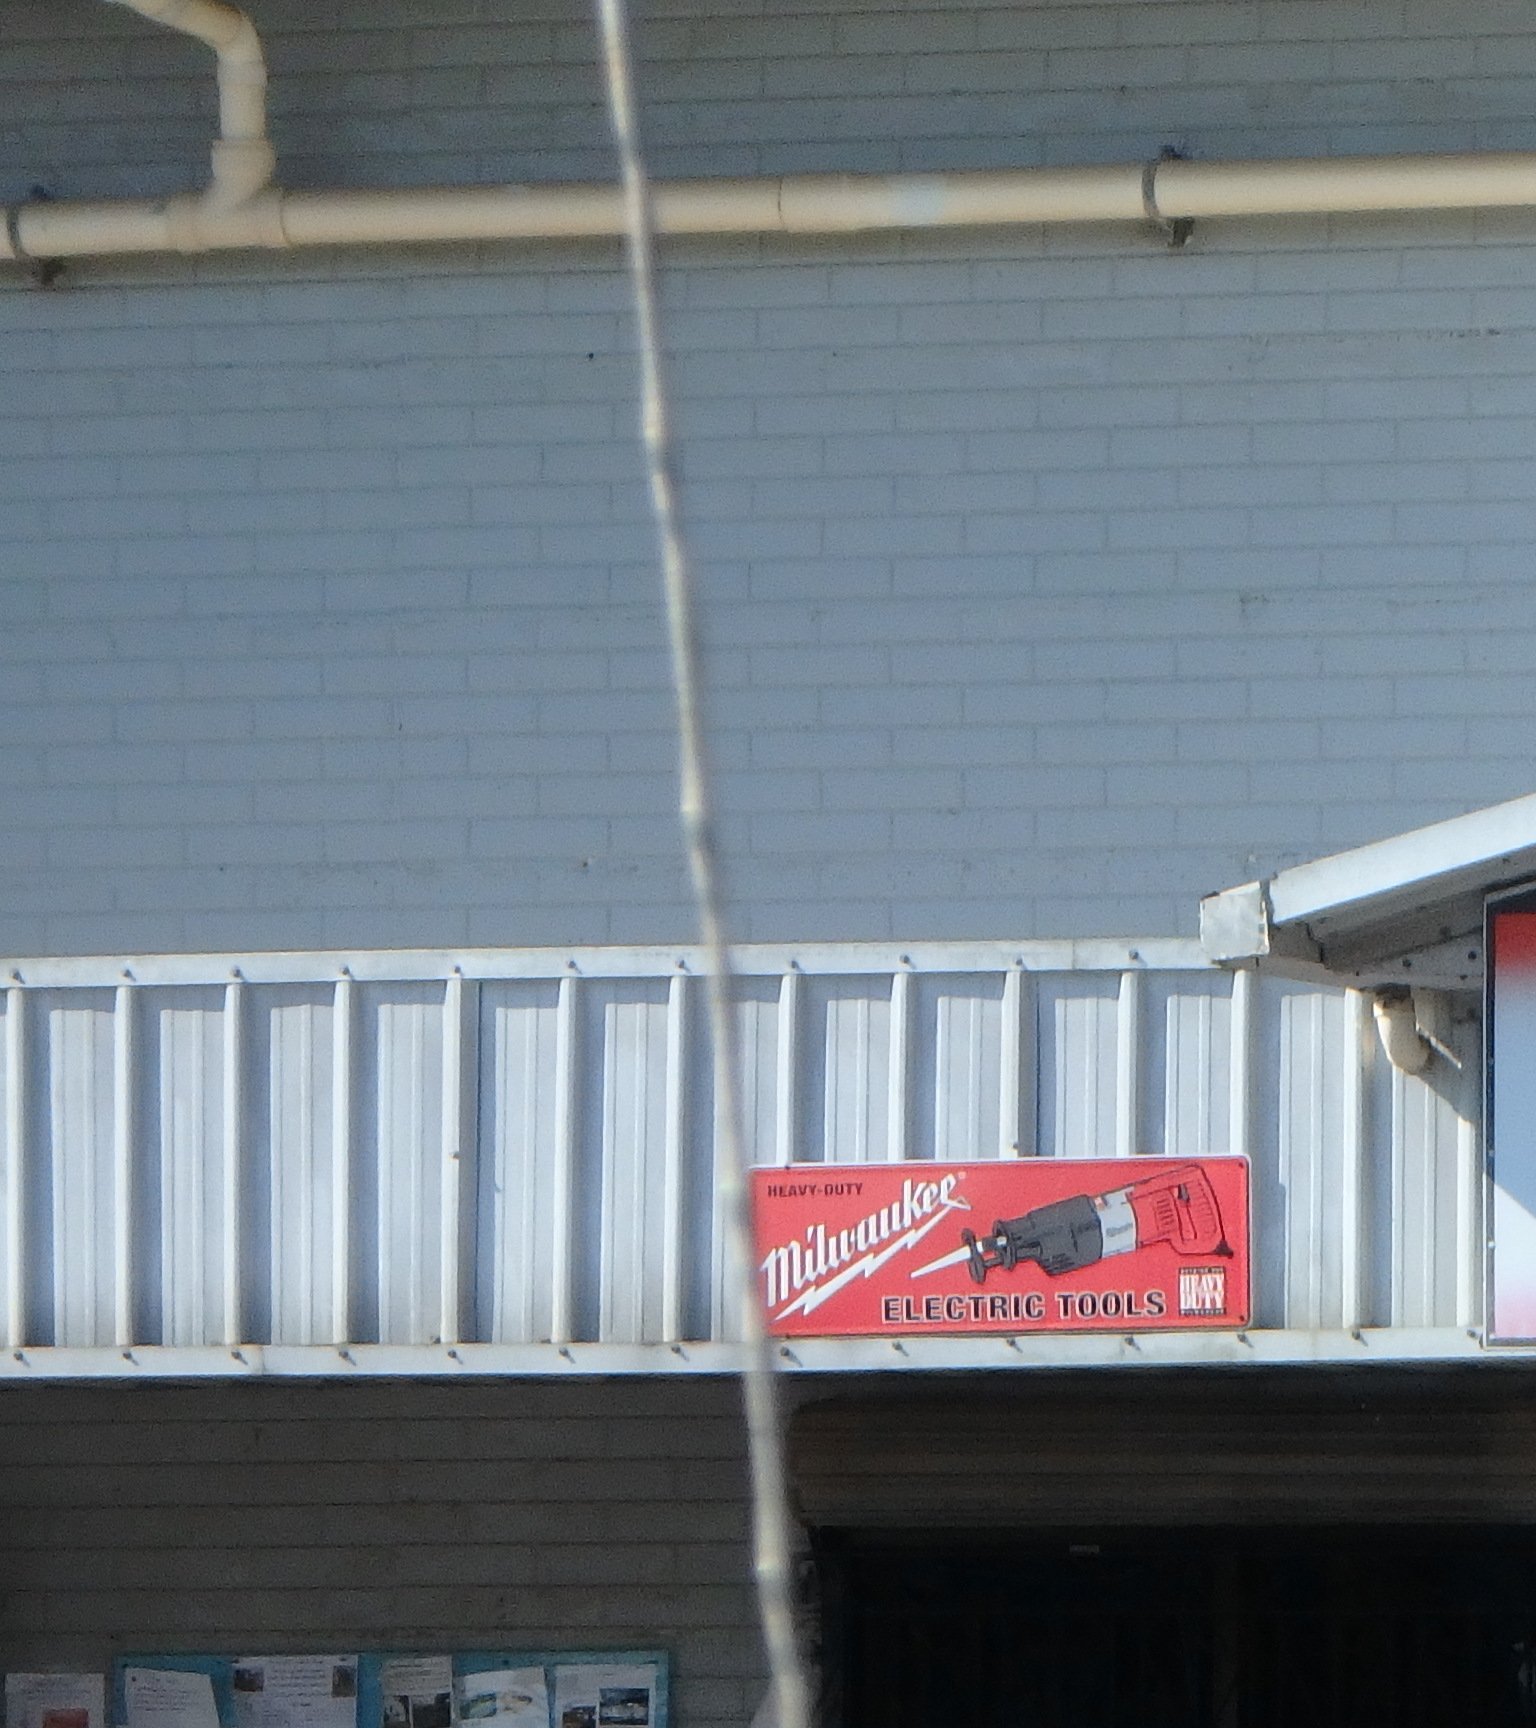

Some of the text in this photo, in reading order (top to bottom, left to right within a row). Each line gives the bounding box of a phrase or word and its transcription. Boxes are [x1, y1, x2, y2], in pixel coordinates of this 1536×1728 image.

[767, 1183, 863, 1198] HEAVY-DUTY
[760, 1173, 957, 1308] Milwaukee
[882, 1290, 1166, 1324] ELECTRIC TOOLS
